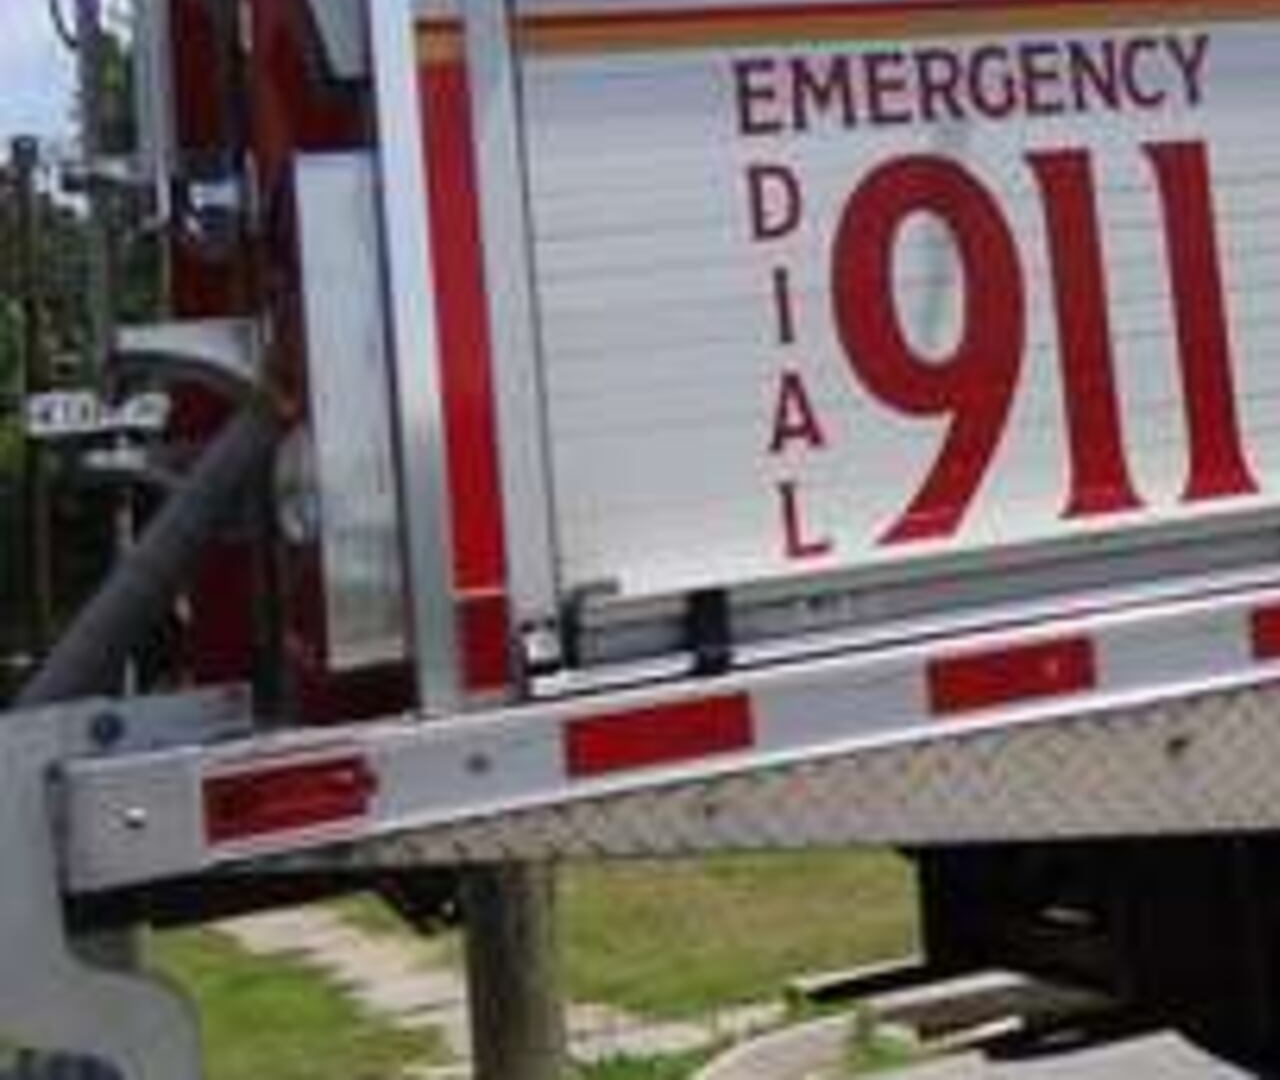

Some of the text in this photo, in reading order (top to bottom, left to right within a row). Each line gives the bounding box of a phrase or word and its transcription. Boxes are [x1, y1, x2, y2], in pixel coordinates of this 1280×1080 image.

[733, 34, 1210, 135] EMERGENCY
[746, 164, 833, 559] DIAL
[831, 139, 1260, 546] 911
